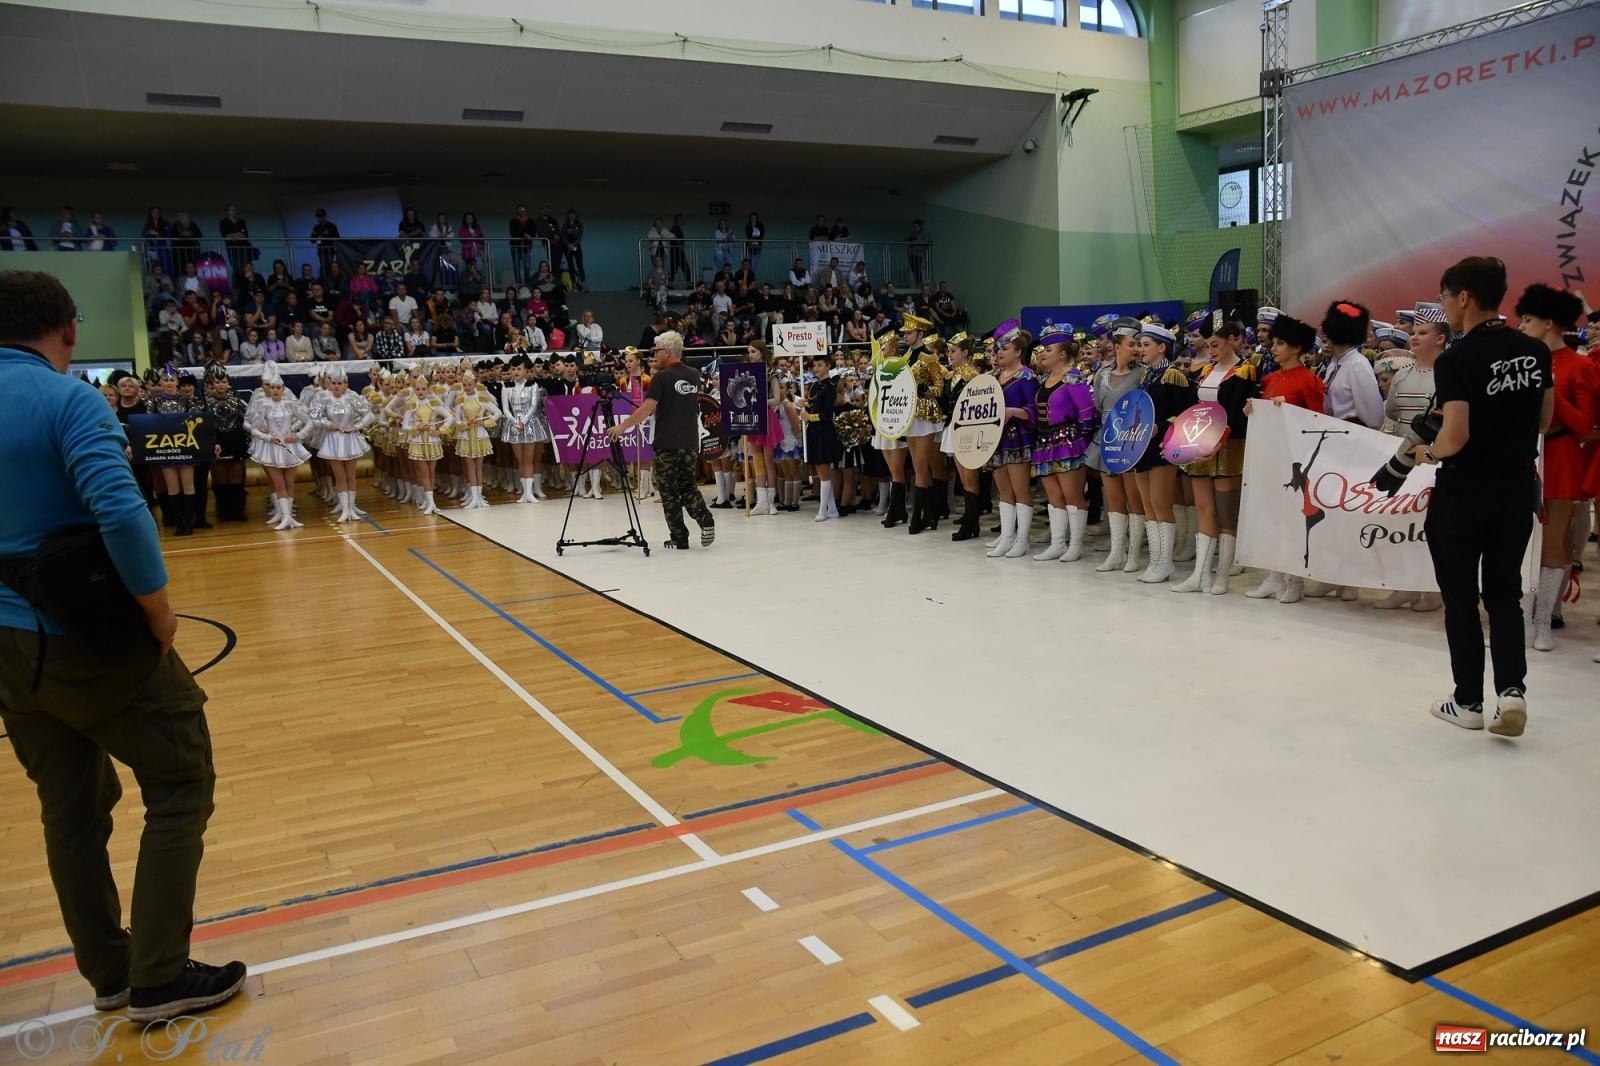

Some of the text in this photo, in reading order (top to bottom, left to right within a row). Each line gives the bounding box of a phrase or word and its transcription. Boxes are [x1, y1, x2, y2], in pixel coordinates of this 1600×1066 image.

[787, 330, 813, 341] Presto
[1490, 355, 1537, 376] FOTO
[966, 384, 996, 398] Mażoretki
[1486, 369, 1542, 396] GANS
[880, 384, 909, 415] Fenix
[959, 396, 998, 421] Fresh
[145, 432, 200, 451] ZARA
[1103, 417, 1149, 444] Scarlet
